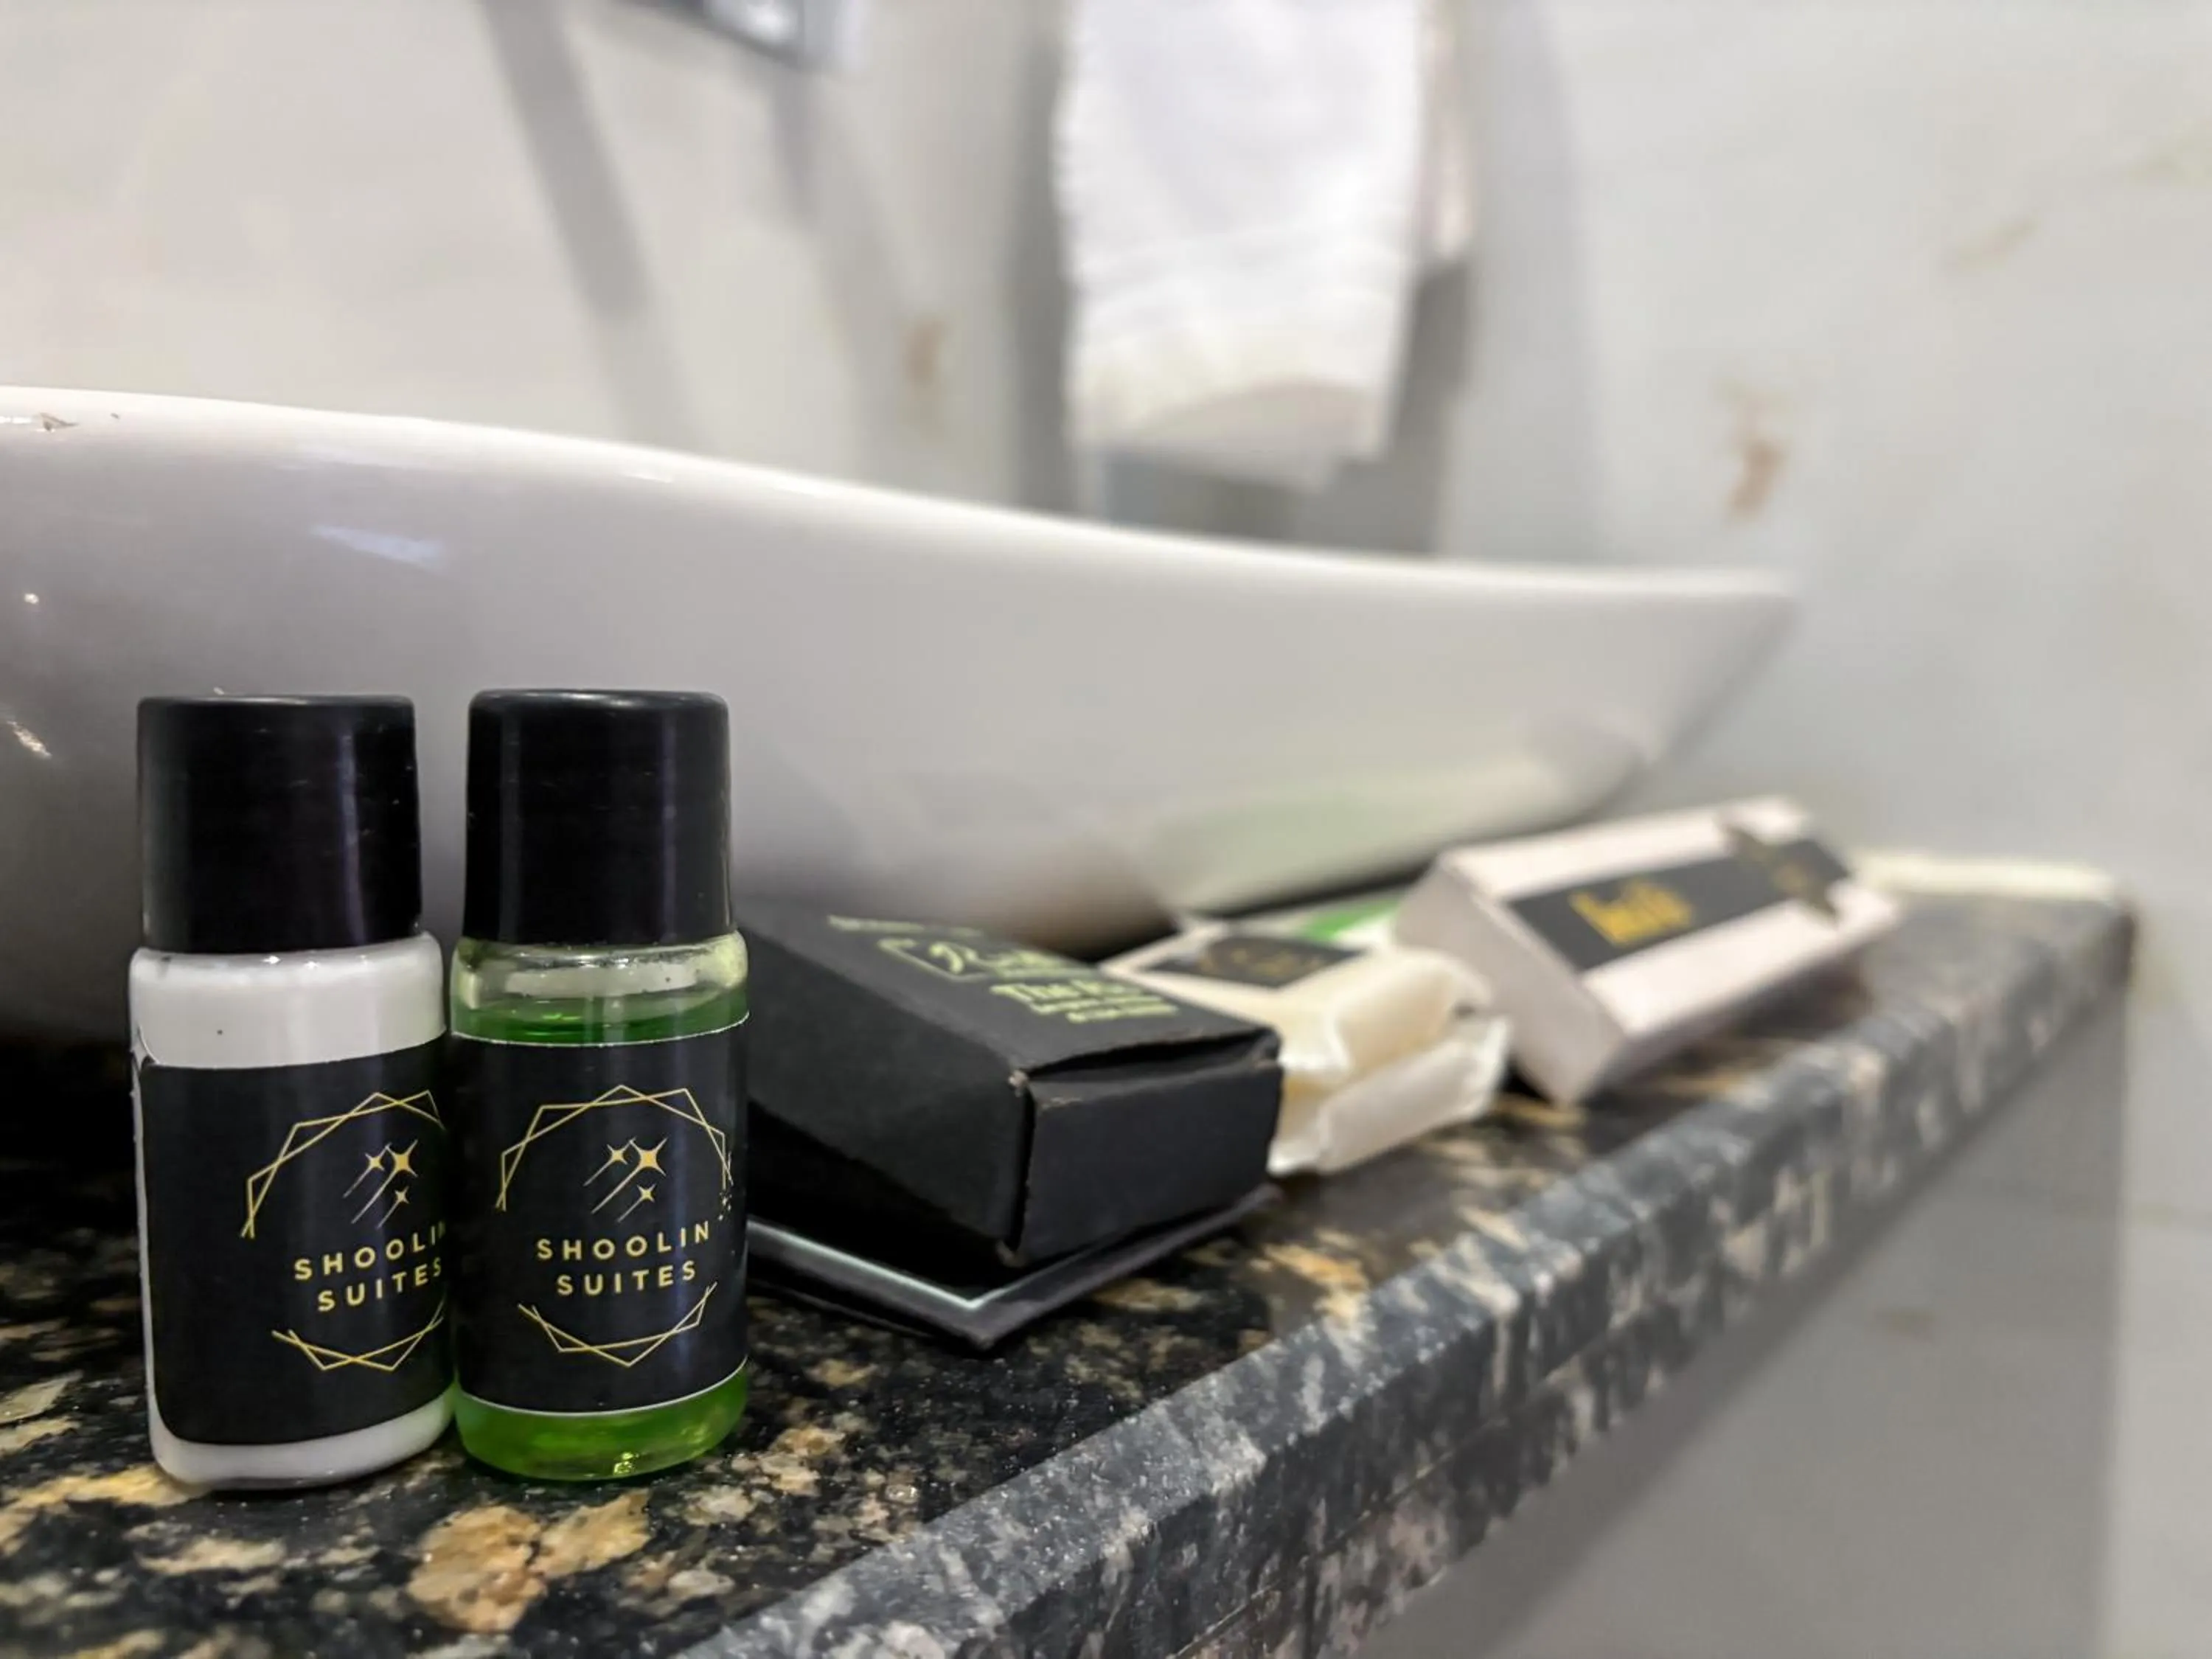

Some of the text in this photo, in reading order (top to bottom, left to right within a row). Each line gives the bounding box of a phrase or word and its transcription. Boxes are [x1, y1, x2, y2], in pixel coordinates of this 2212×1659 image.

[536, 1220, 709, 1261] SHOOLIN
[317, 1256, 442, 1312] SUITES
[556, 1259, 695, 1296] SUITES
